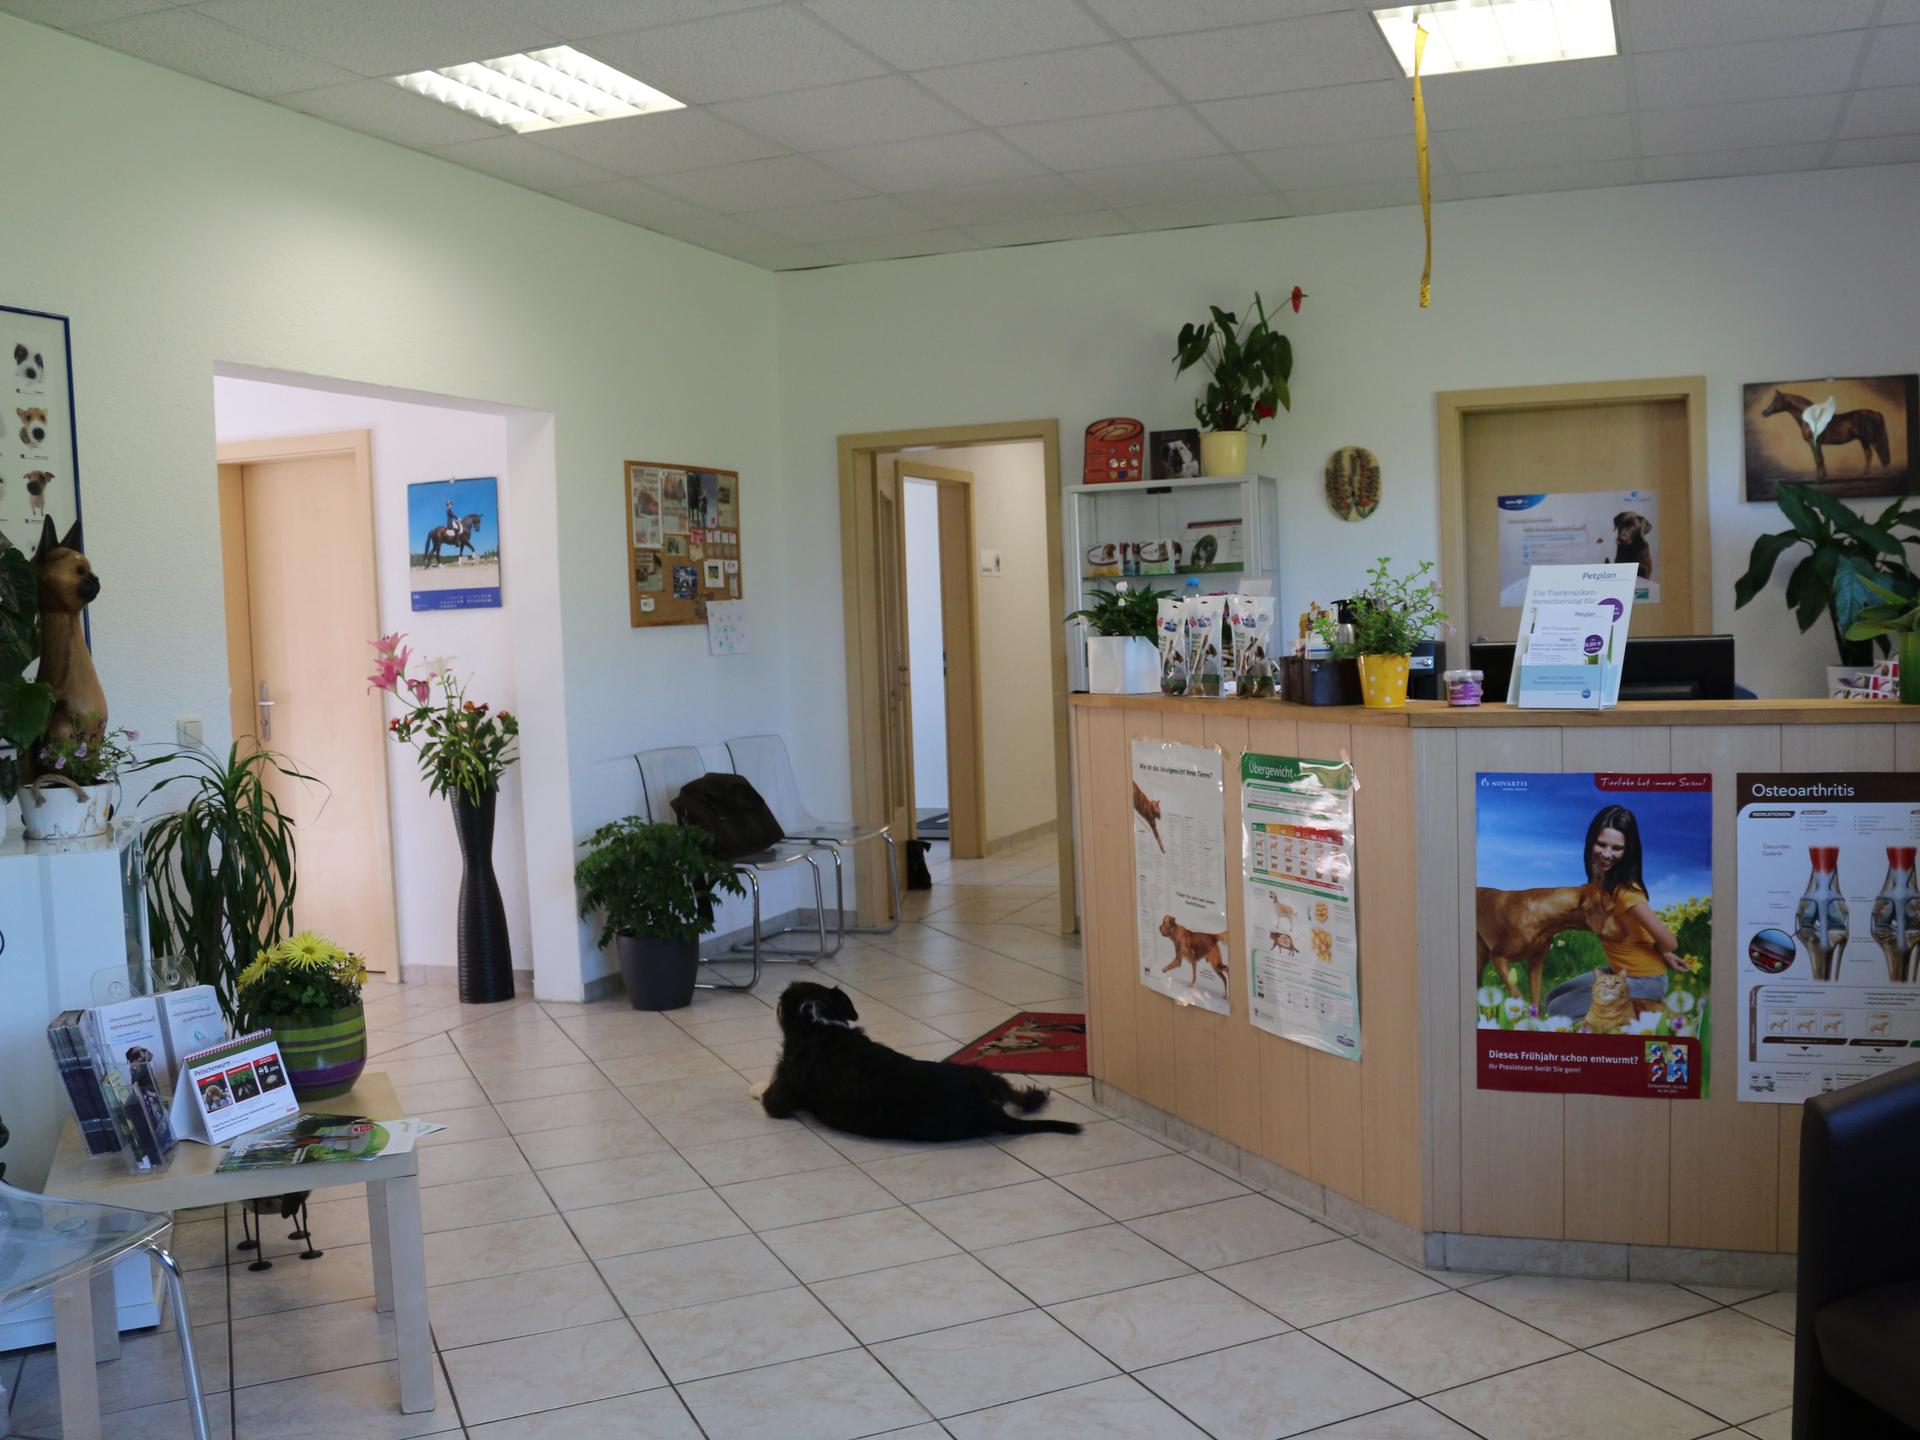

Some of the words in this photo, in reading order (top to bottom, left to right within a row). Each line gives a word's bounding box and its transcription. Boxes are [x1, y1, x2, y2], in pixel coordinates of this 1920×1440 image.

[1582, 571, 1617, 580] Petplan
[1491, 780, 1528, 788] NOVARTIS
[1751, 783, 1855, 798] Osteoarthritis
[1488, 1050, 1519, 1060] Dieses
[1520, 1051, 1559, 1063] Frühjahr
[1560, 1053, 1588, 1063] schon
[1590, 1055, 1640, 1066] entwurmt?
